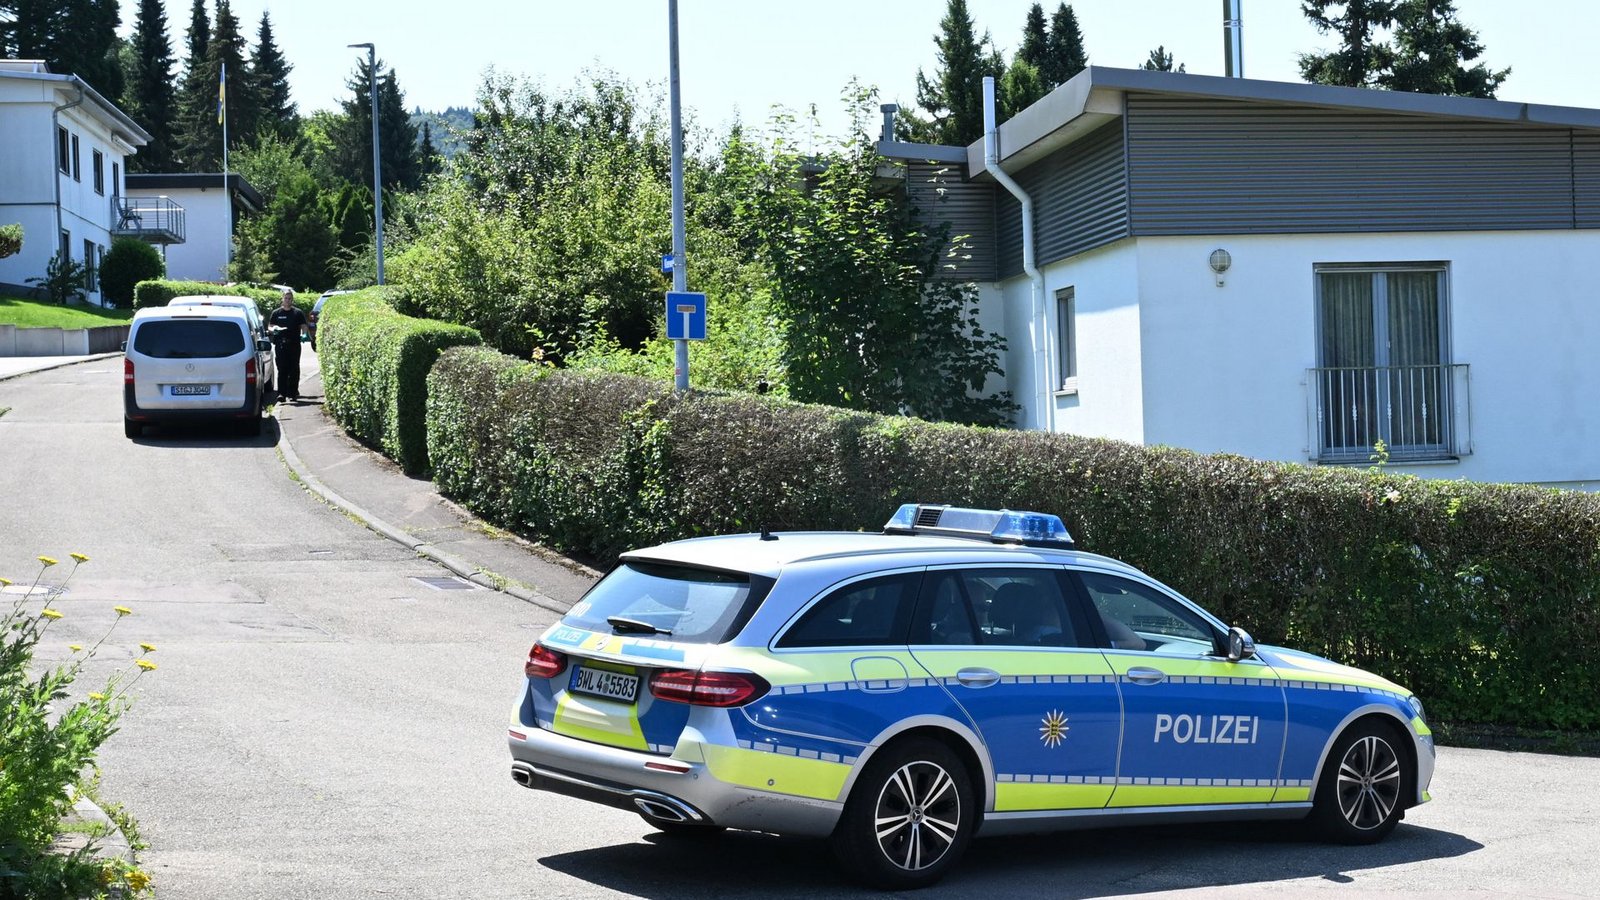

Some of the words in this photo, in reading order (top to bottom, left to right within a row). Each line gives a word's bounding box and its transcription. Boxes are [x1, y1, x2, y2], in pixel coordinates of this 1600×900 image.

[576, 670, 594, 691] BWL
[597, 673, 603, 693] 4
[609, 676, 637, 698] 5583
[1153, 713, 1259, 744] POLIZEI
